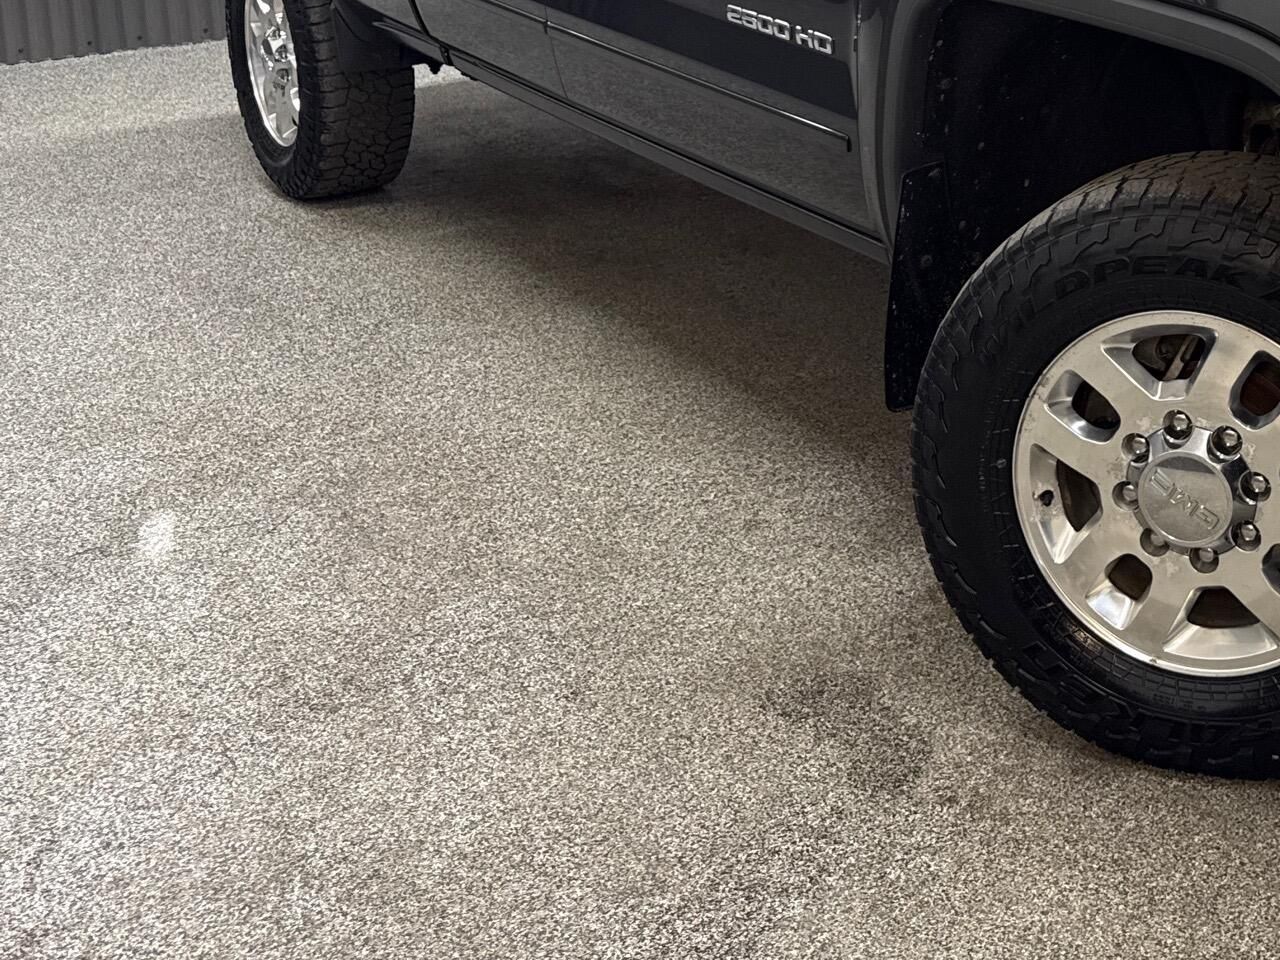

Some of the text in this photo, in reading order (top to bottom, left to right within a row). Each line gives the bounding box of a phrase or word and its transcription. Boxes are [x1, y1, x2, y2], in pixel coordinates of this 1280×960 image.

[726, 4, 832, 55] 2500 HD
[1150, 466, 1221, 531] GMC
